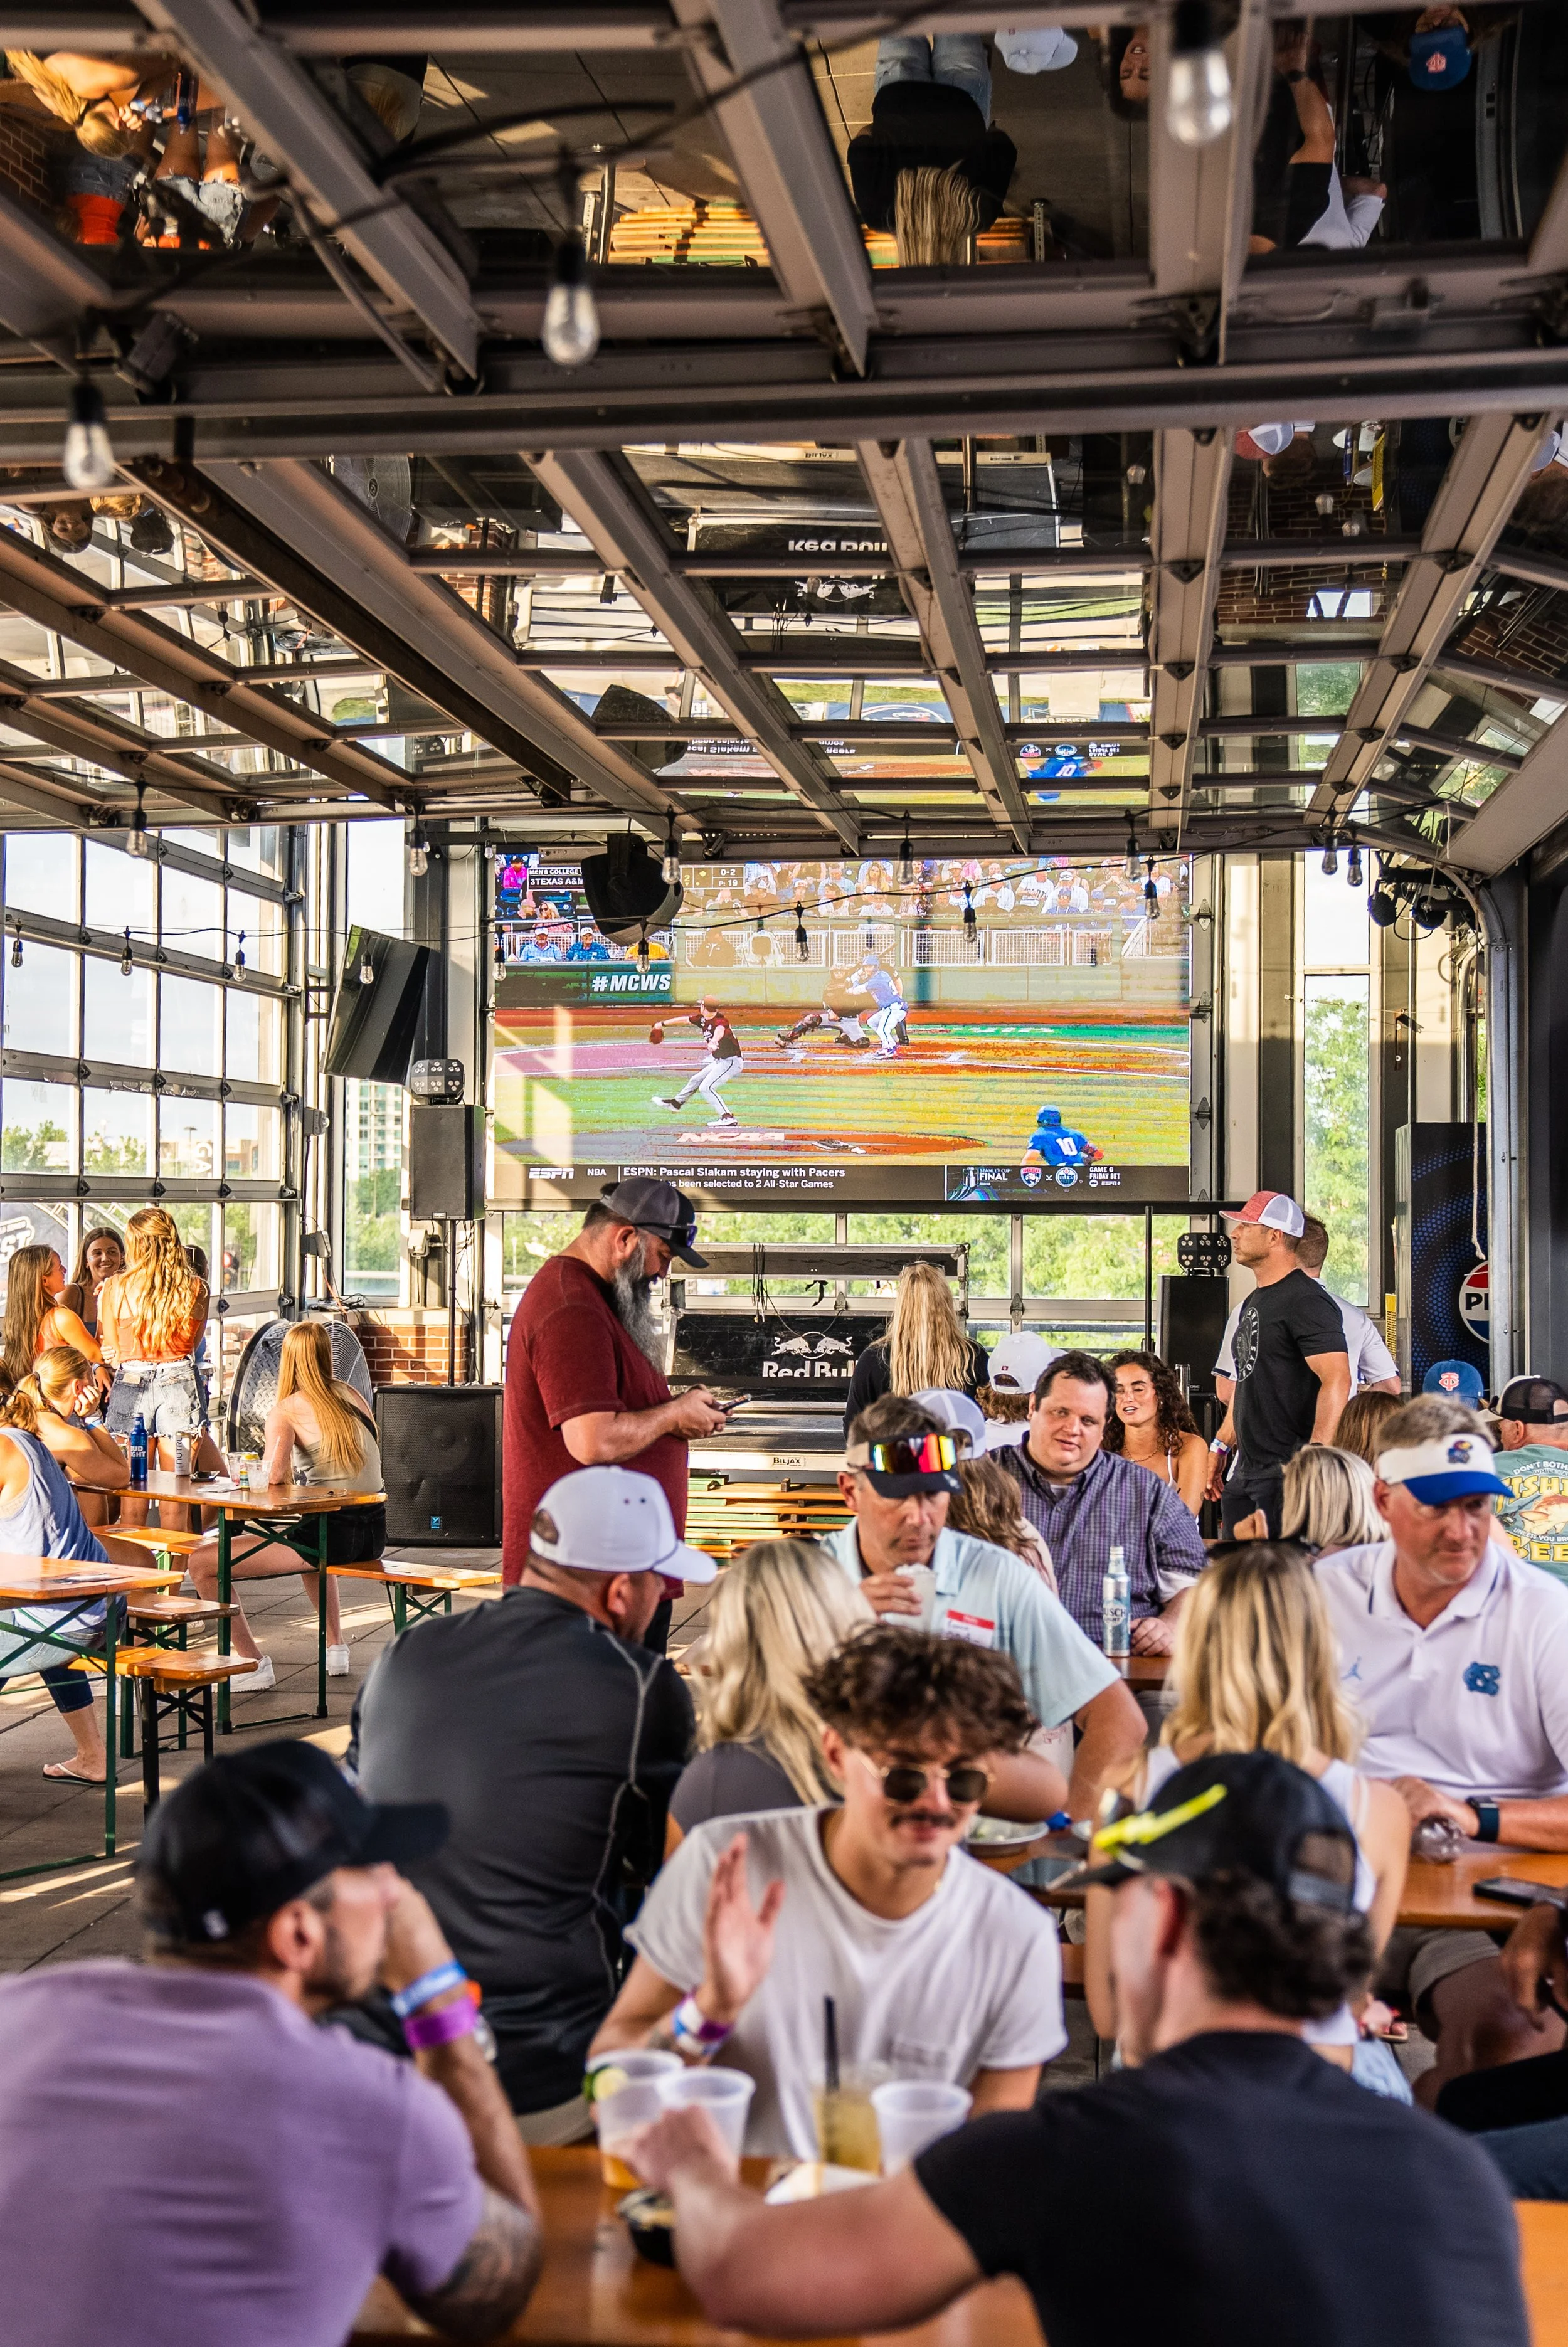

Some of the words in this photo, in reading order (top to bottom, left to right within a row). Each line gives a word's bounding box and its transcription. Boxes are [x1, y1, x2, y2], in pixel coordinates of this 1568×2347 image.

[591, 974, 671, 992] #MCWS
[529, 1168, 575, 1179] ESPN
[623, 1167, 657, 1176] ESPN:
[660, 1167, 694, 1177] Pascal
[697, 1167, 738, 1177] Siakam
[739, 1168, 780, 1179] staying
[782, 1167, 806, 1177] with
[808, 1168, 845, 1177] Pacers
[980, 1172, 1008, 1180] FINAL
[679, 1179, 701, 1188] been
[703, 1179, 743, 1188] selected
[744, 1180, 754, 1188] to
[763, 1179, 798, 1188] All-Star
[801, 1180, 834, 1188] Games
[1465, 1293, 1488, 1311] P
[762, 1360, 811, 1377] Red
[815, 1360, 859, 1377] Bul
[1513, 1461, 1541, 1475] DON'T
[1513, 1527, 1537, 1540] UNLESS
